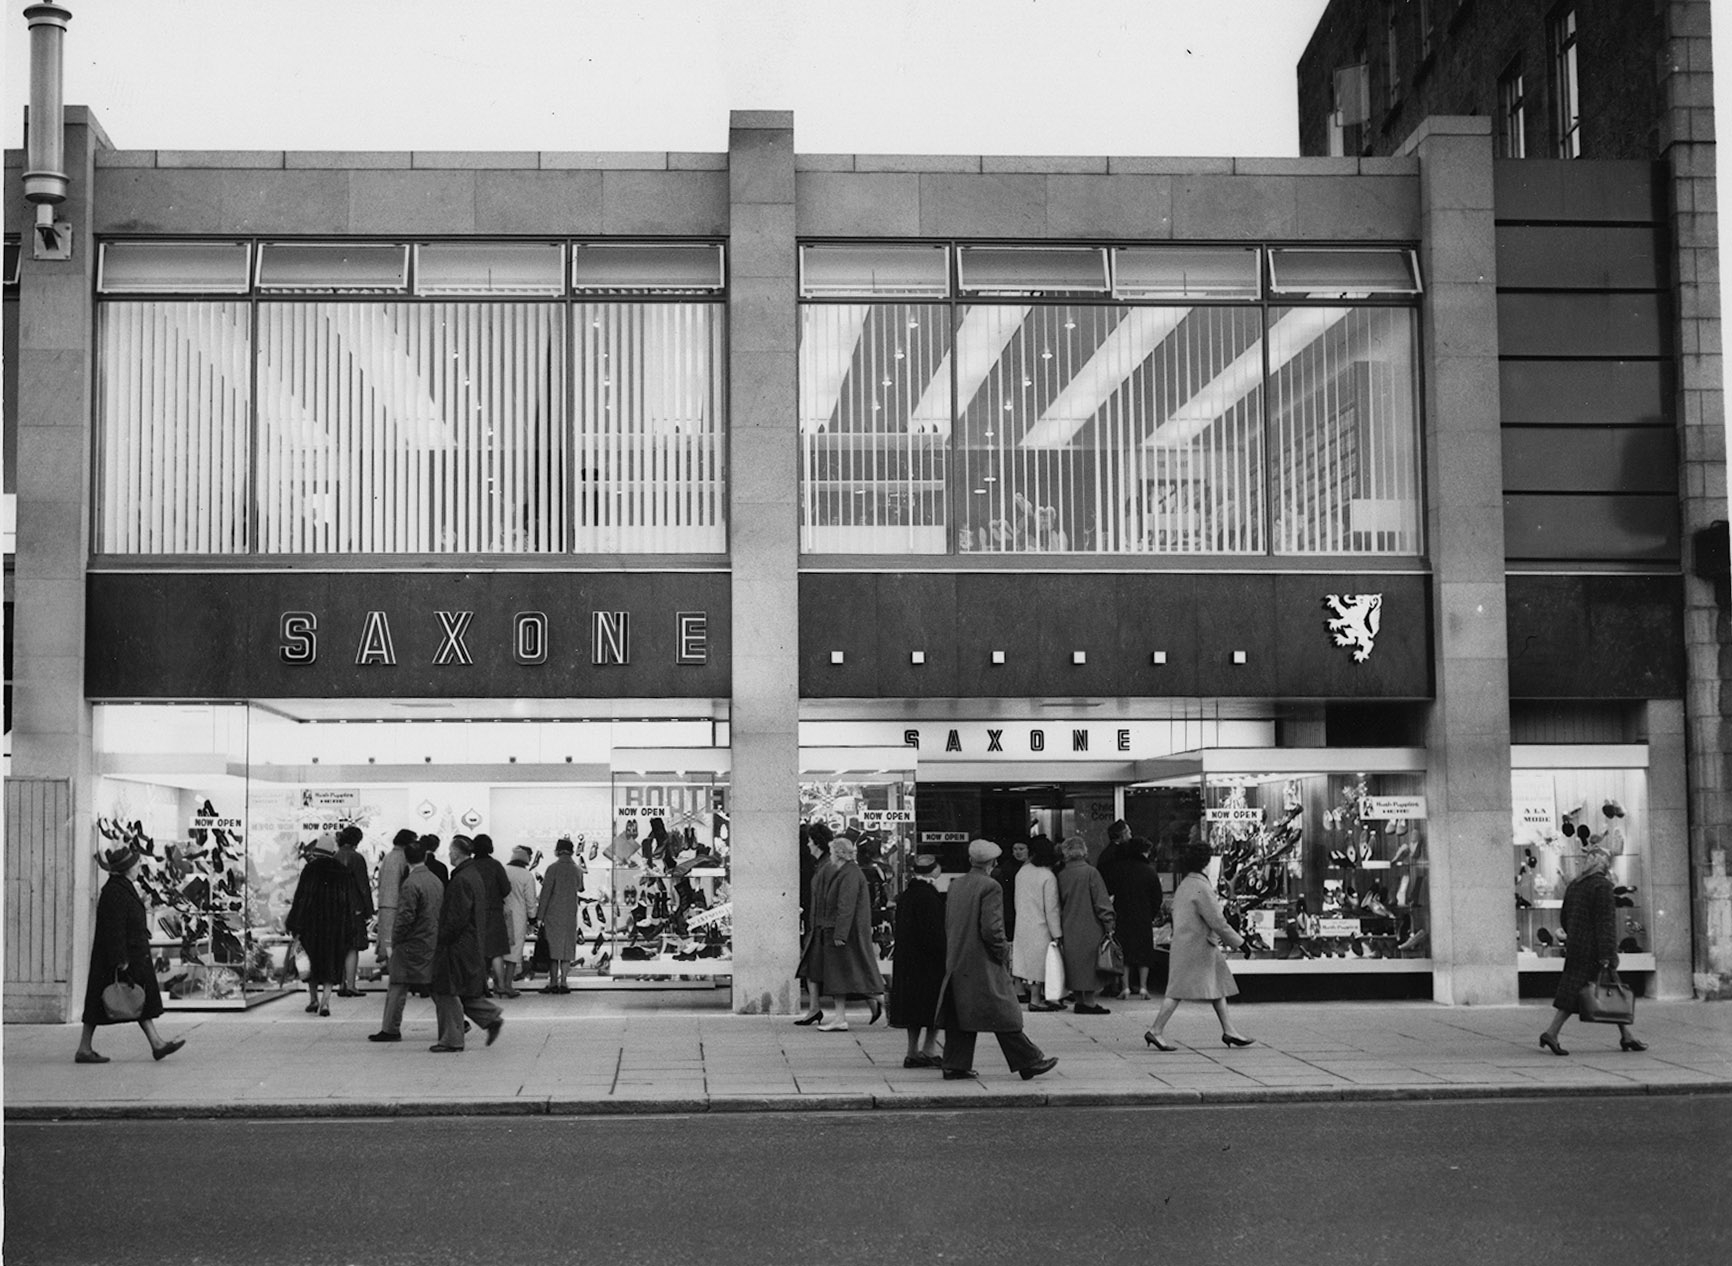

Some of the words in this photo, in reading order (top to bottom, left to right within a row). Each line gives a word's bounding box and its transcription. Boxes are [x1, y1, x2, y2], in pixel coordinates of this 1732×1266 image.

[278, 611, 708, 665] SAXONE
[904, 729, 1131, 752] SAXONE
[618, 807, 637, 816] NOW
[641, 807, 665, 816] OPEN
[864, 811, 883, 820] NOW
[886, 811, 910, 820] OPEN
[1211, 810, 1230, 819] NOW
[1233, 810, 1257, 819] OPEN
[195, 818, 214, 827] NOW
[217, 818, 242, 827] OPEN
[303, 822, 320, 830] NOW
[322, 822, 344, 830] OPEN
[926, 833, 942, 841] NOW
[944, 833, 965, 841] OPEN
